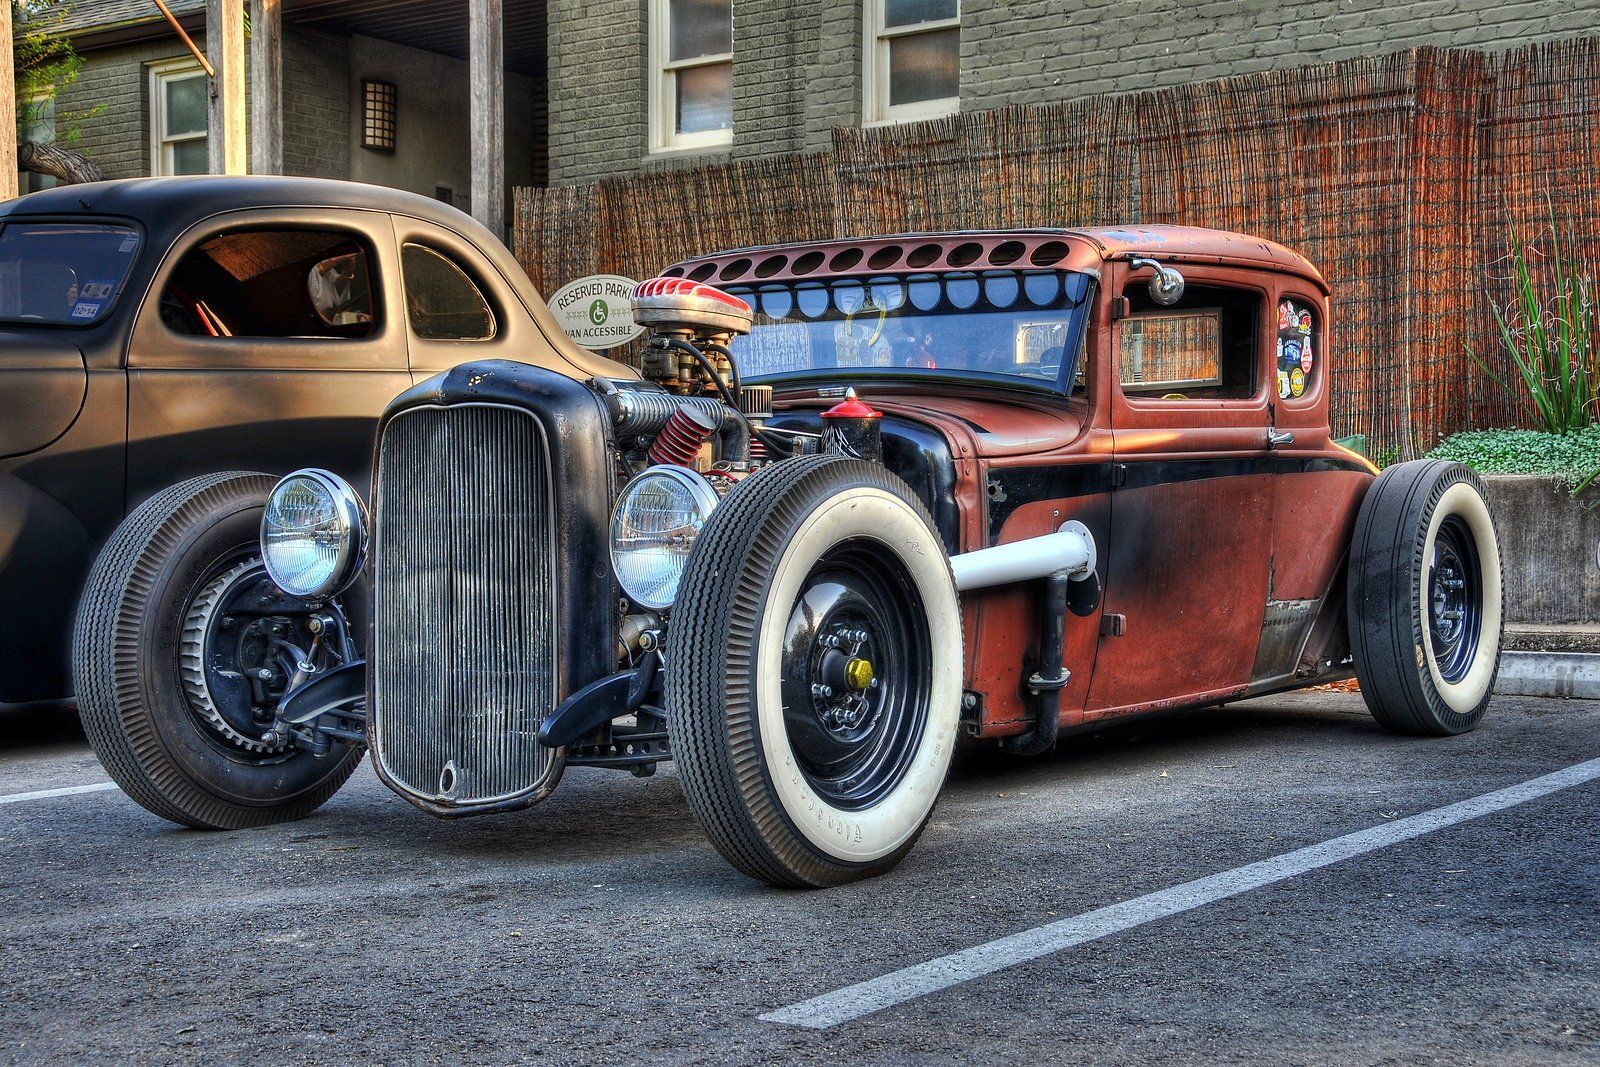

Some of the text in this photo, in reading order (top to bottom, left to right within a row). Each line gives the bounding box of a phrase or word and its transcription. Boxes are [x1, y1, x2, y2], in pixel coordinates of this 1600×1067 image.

[557, 283, 632, 310] RESERVED PARKI
[583, 325, 632, 338] ACCESSIBLE
